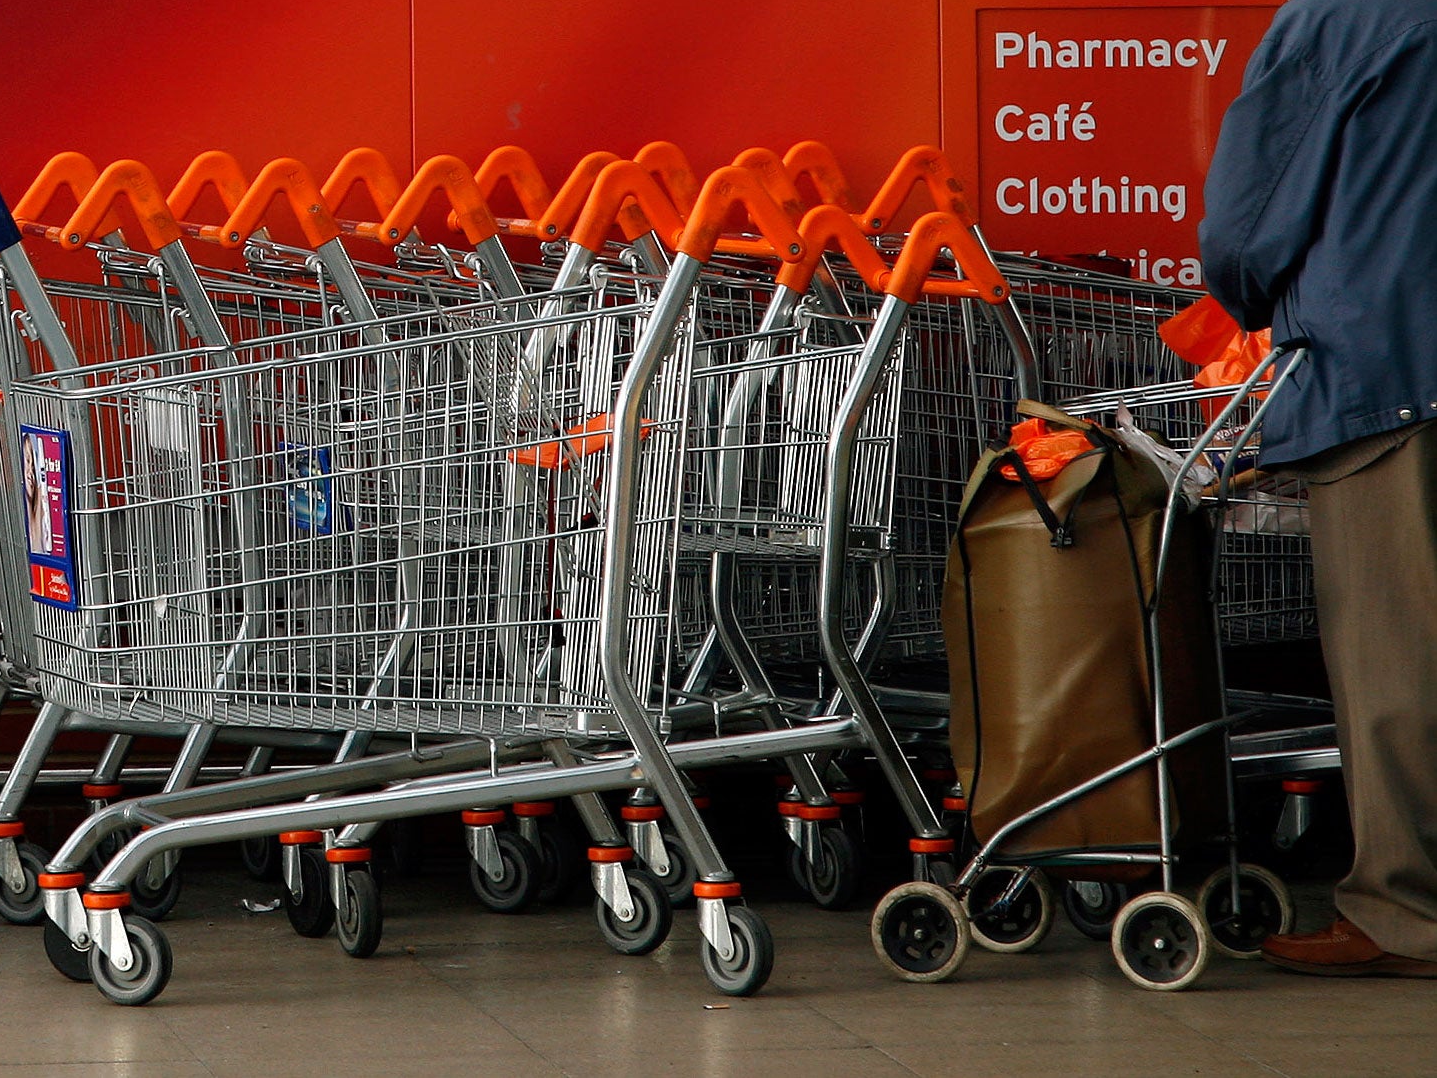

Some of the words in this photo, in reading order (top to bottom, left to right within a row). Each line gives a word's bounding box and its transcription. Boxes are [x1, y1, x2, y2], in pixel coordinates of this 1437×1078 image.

[996, 32, 1227, 75] Pharmacy
[996, 102, 1095, 141] Café
[996, 176, 1185, 221] Clothing
